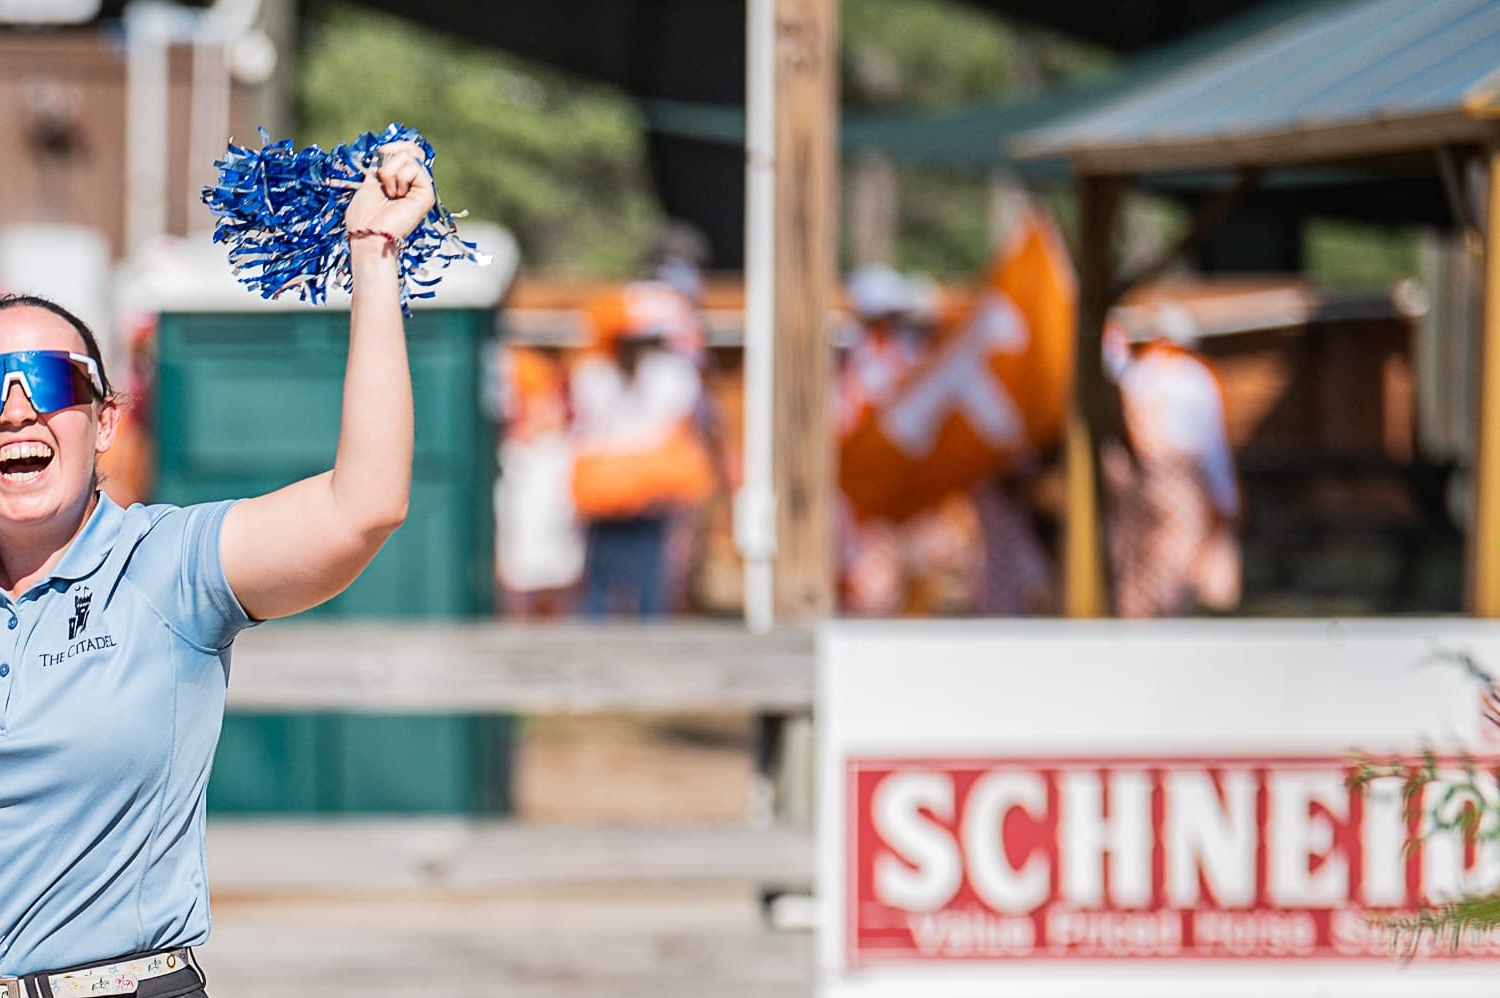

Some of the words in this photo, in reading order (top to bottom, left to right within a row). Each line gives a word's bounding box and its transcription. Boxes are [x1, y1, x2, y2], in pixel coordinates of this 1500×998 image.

[39, 651, 66, 667] THE
[67, 635, 117, 658] CITADEL
[905, 908, 1036, 955] Value
[1046, 906, 1183, 955] Priced
[1194, 907, 1317, 955] Horse
